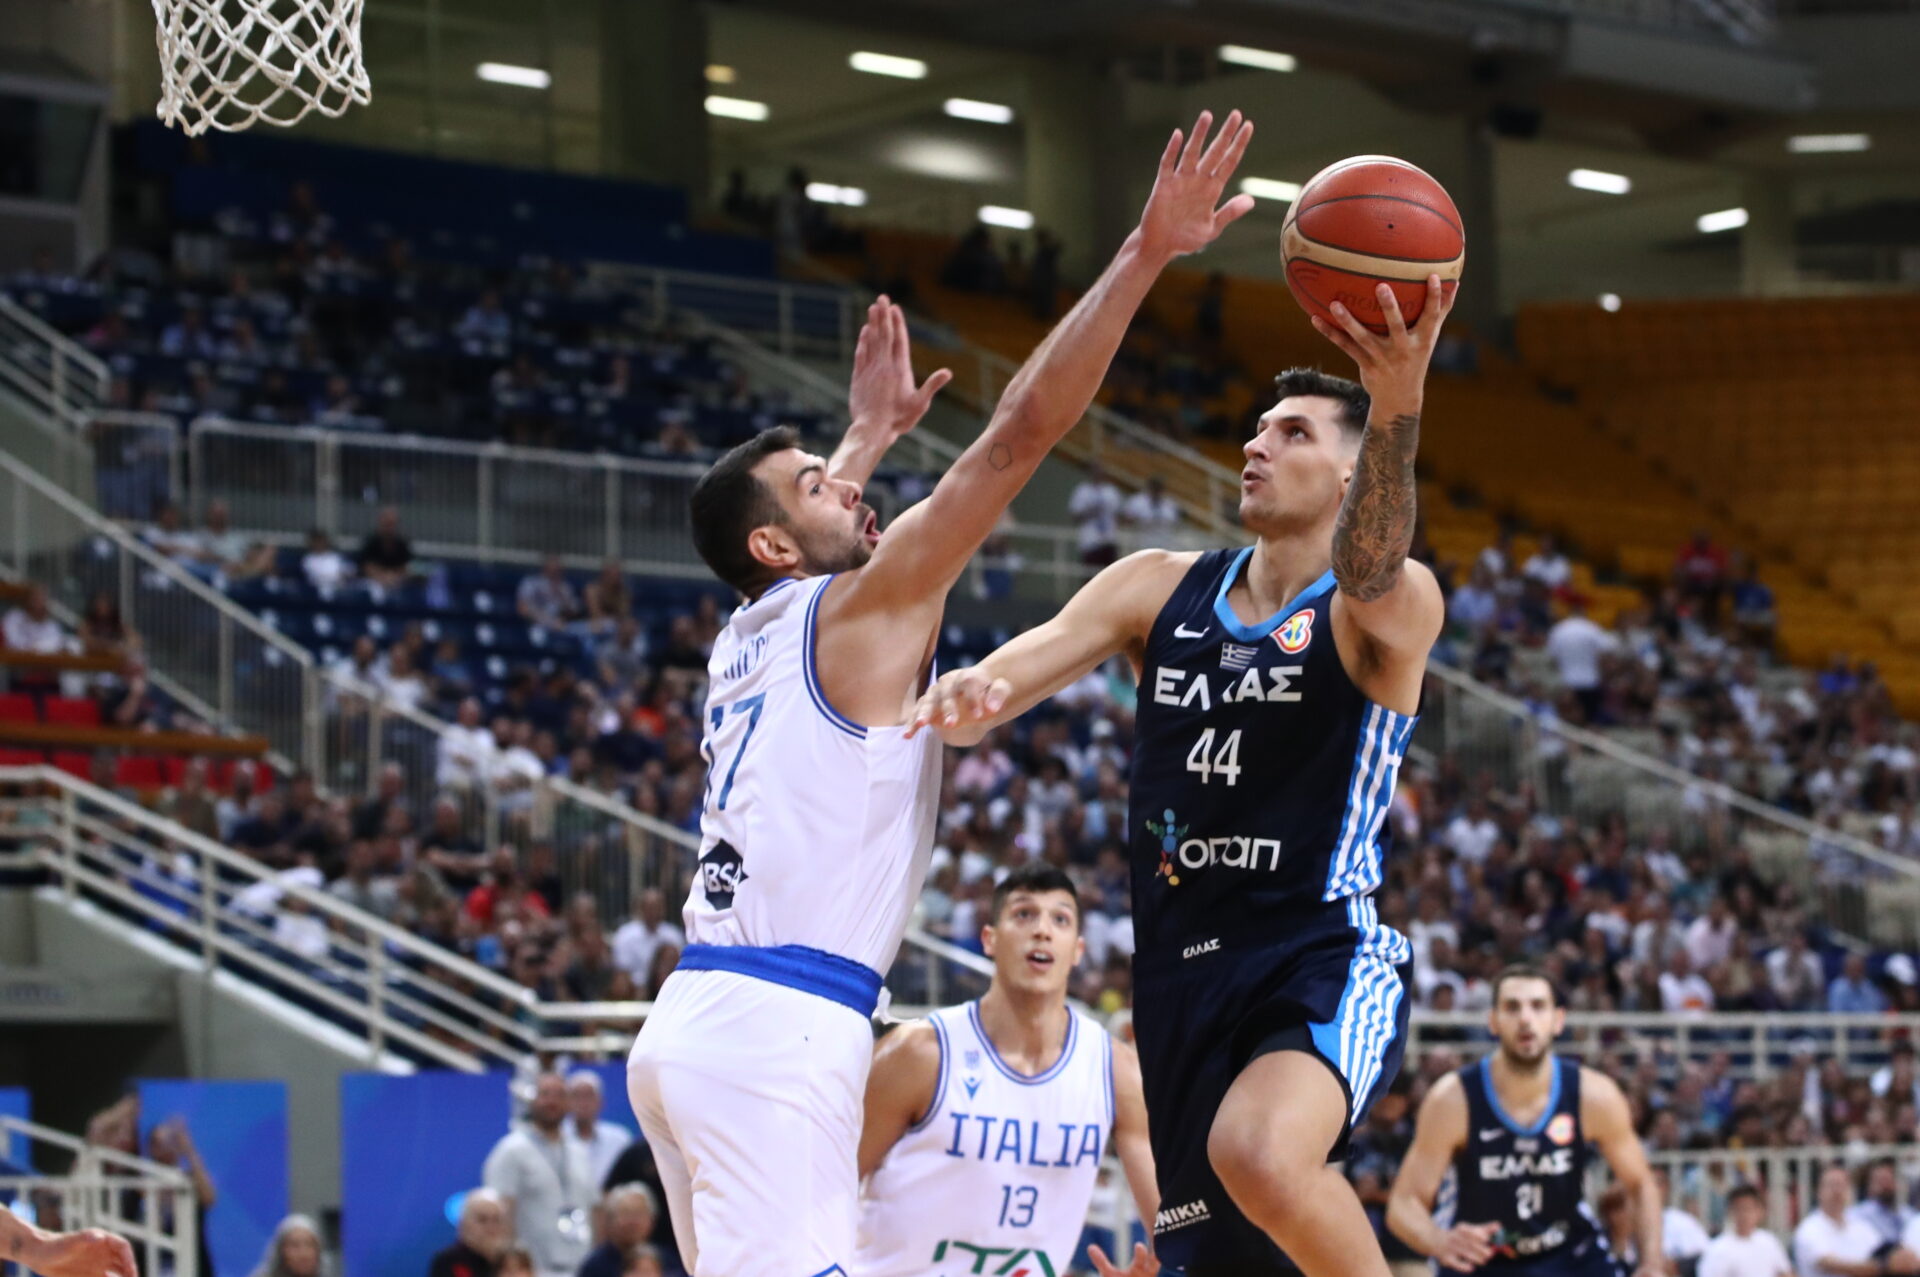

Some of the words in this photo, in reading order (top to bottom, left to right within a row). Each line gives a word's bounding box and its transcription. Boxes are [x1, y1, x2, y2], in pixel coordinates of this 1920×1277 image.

[1186, 727, 1242, 786] 44
[945, 1112, 1100, 1167] ITALIA
[998, 1185, 1039, 1228] 13
[1154, 1199, 1208, 1229] ΝΙΚΗ
